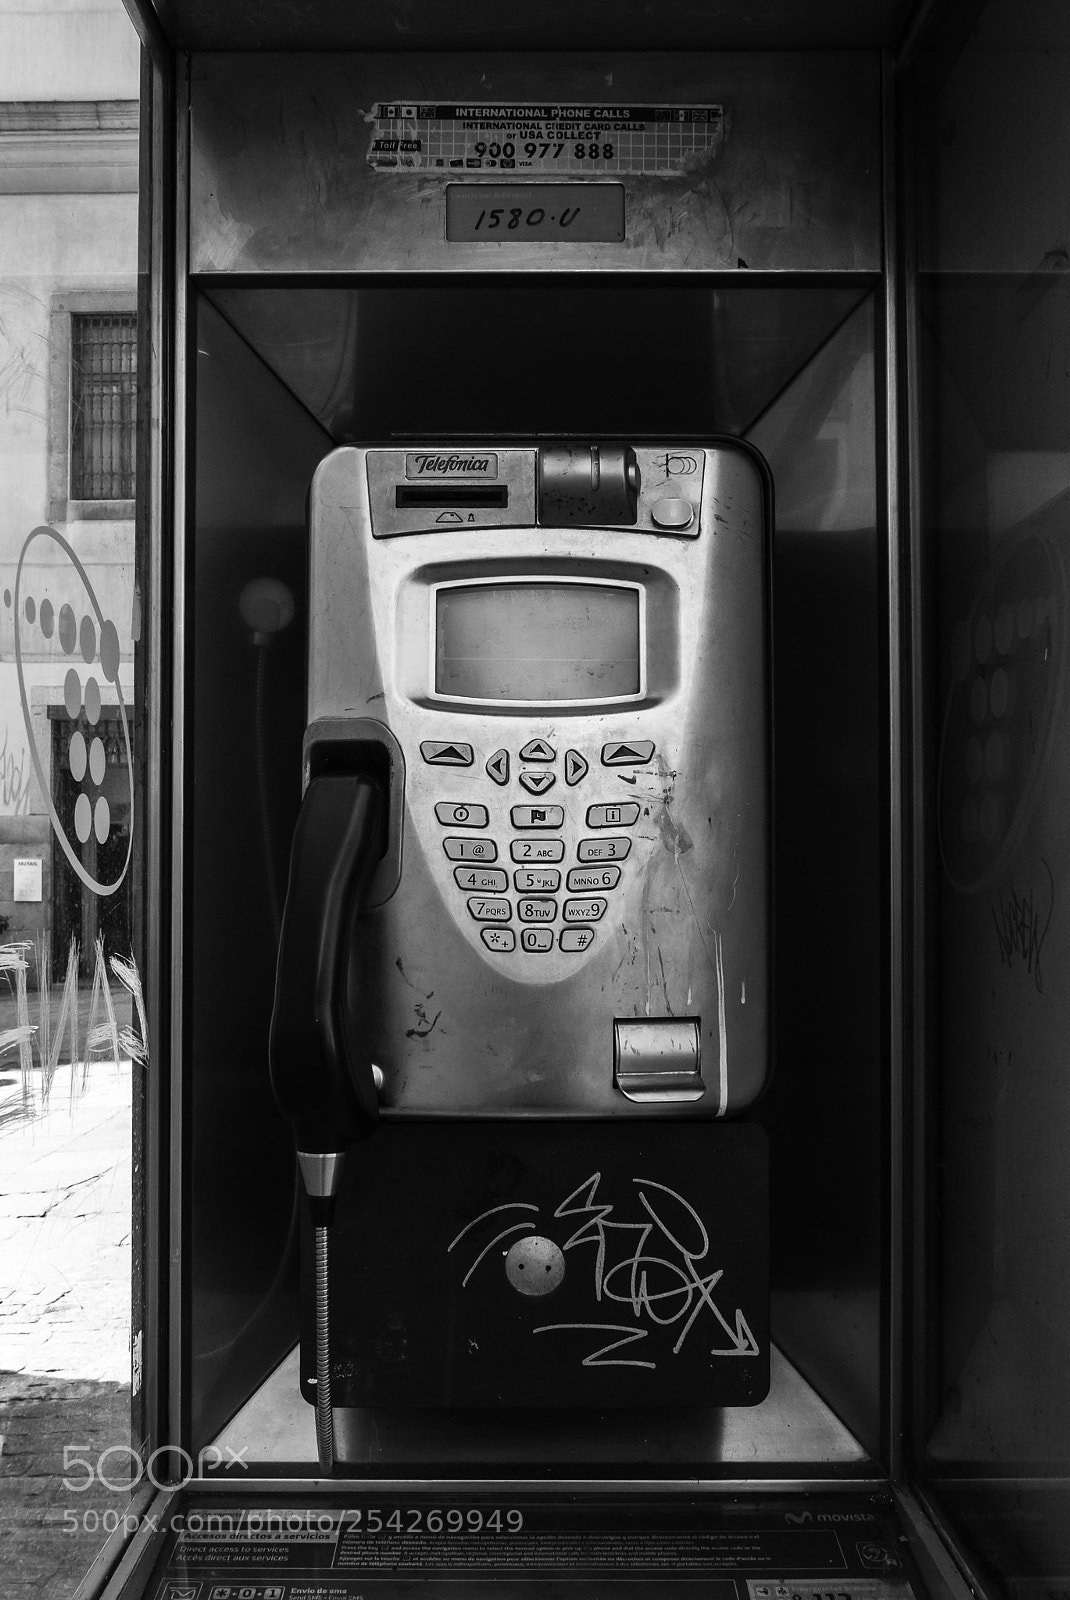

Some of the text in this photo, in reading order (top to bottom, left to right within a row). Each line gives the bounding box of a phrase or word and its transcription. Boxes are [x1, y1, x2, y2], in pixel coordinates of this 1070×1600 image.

[455, 108, 631, 118] INTERNATIONAL PHONE CALLS
[462, 122, 543, 130] INTERNATIONAL
[545, 122, 581, 131] CREDIT
[584, 123, 611, 131] CARD
[520, 132, 544, 140] USA
[546, 132, 602, 140] COLLECT
[474, 142, 614, 160] 900 977 888
[459, 844, 485, 857] 1 @
[522, 844, 553, 858] 2 ABC
[588, 843, 617, 857] DEF 3
[468, 872, 496, 886] 4 GHI
[526, 873, 555, 888] 5 JKL
[574, 872, 611, 886] MNÑO 6
[476, 902, 506, 916] 7 PQRS
[524, 904, 551, 918] 8 TUV
[568, 903, 600, 917] WXYZ 9
[527, 934, 537, 947] 0
[577, 934, 588, 946] #
[816, 1512, 876, 1522] movista
[184, 1532, 227, 1540] Accesos
[229, 1532, 273, 1540] directos
[284, 1532, 331, 1540] servicios
[180, 1545, 207, 1553] Direct
[176, 1554, 203, 1562] Accès
[204, 1554, 231, 1562] direct
[252, 1554, 289, 1562] services
